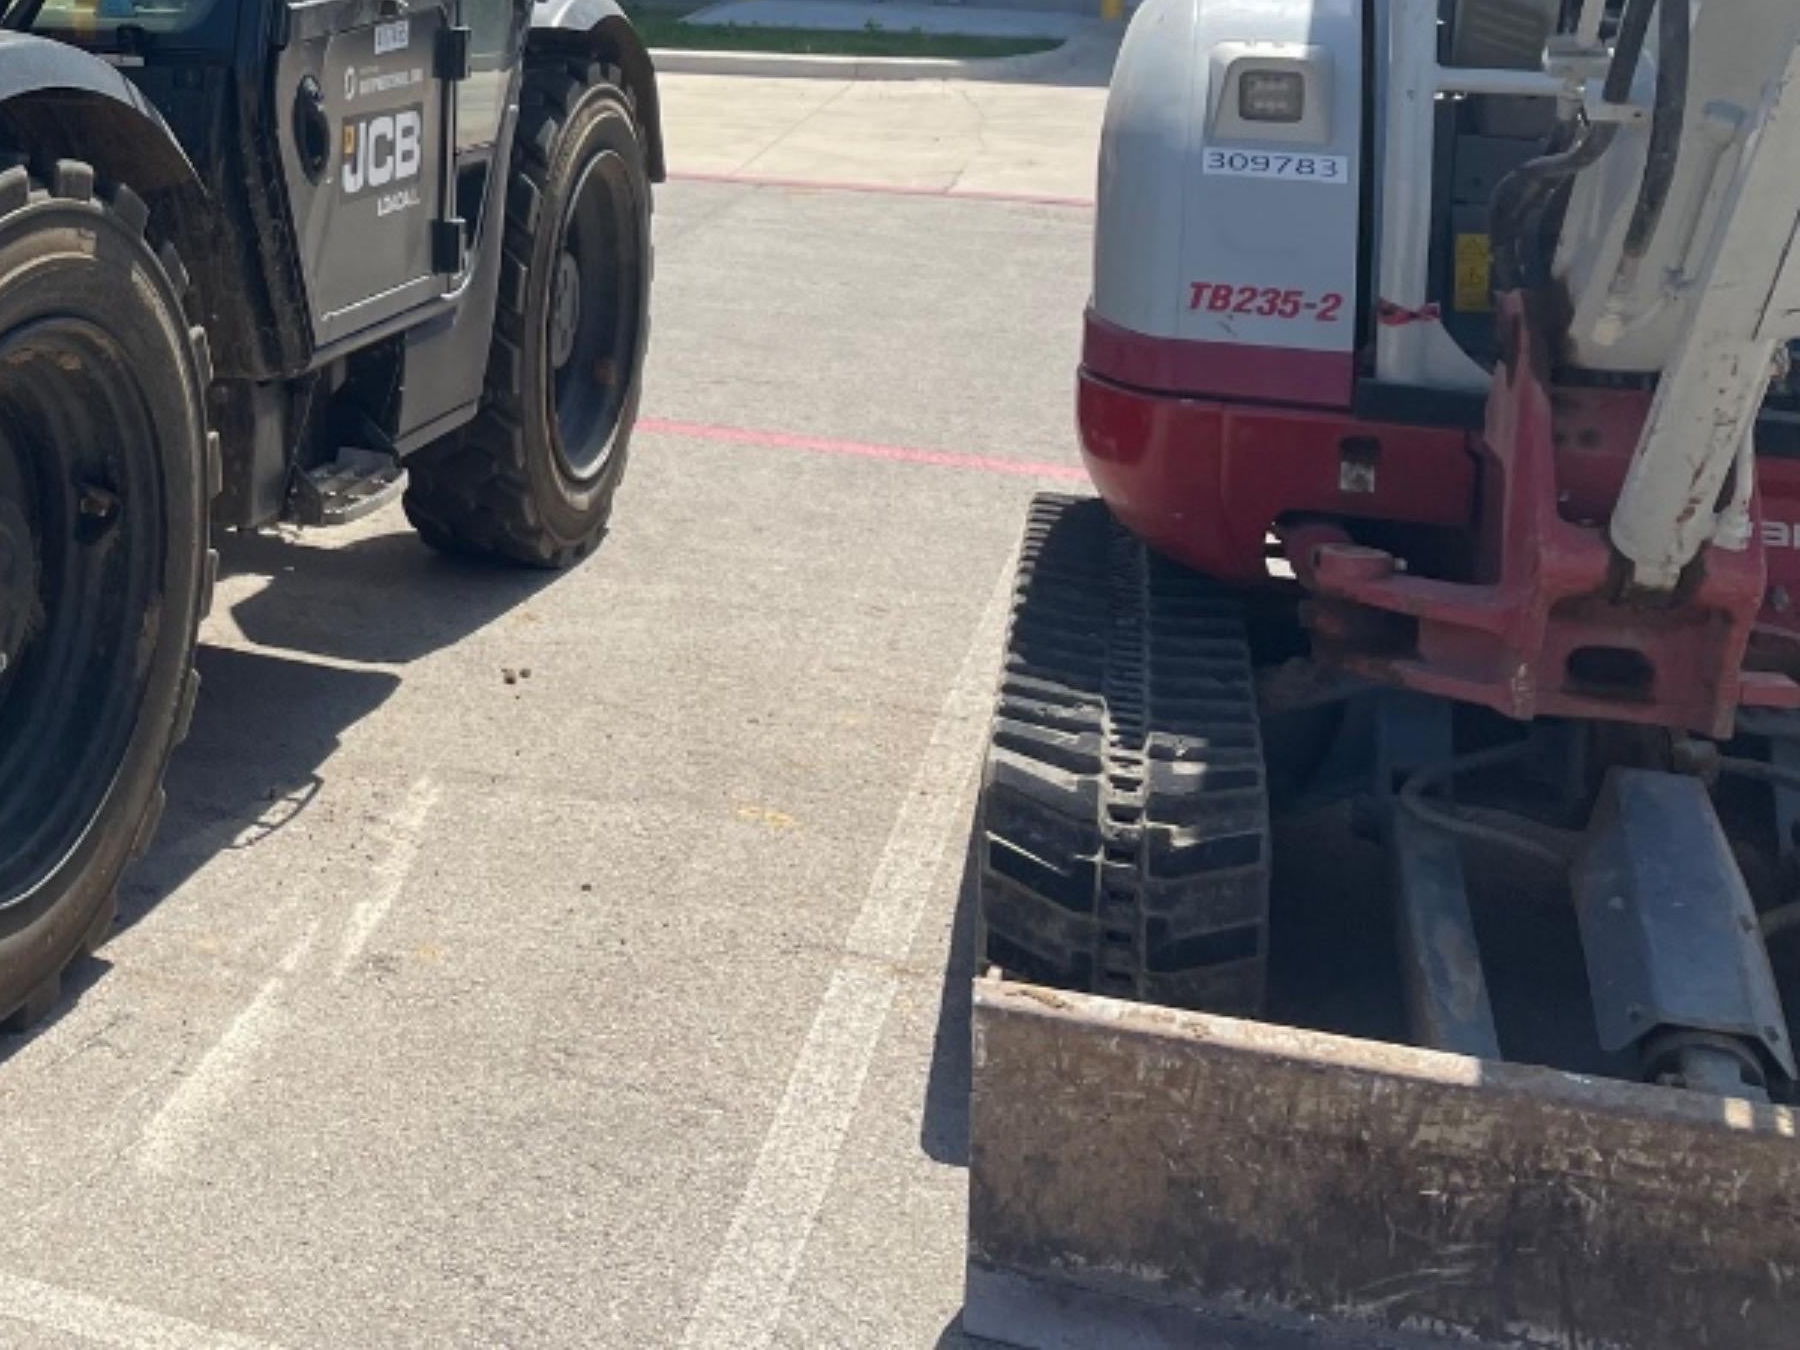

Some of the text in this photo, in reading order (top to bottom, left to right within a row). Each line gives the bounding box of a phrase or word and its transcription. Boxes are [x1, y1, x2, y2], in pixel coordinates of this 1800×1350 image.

[342, 110, 422, 193] JCB
[1207, 152, 1339, 178] 309783
[1189, 282, 1344, 322] TB235-2
